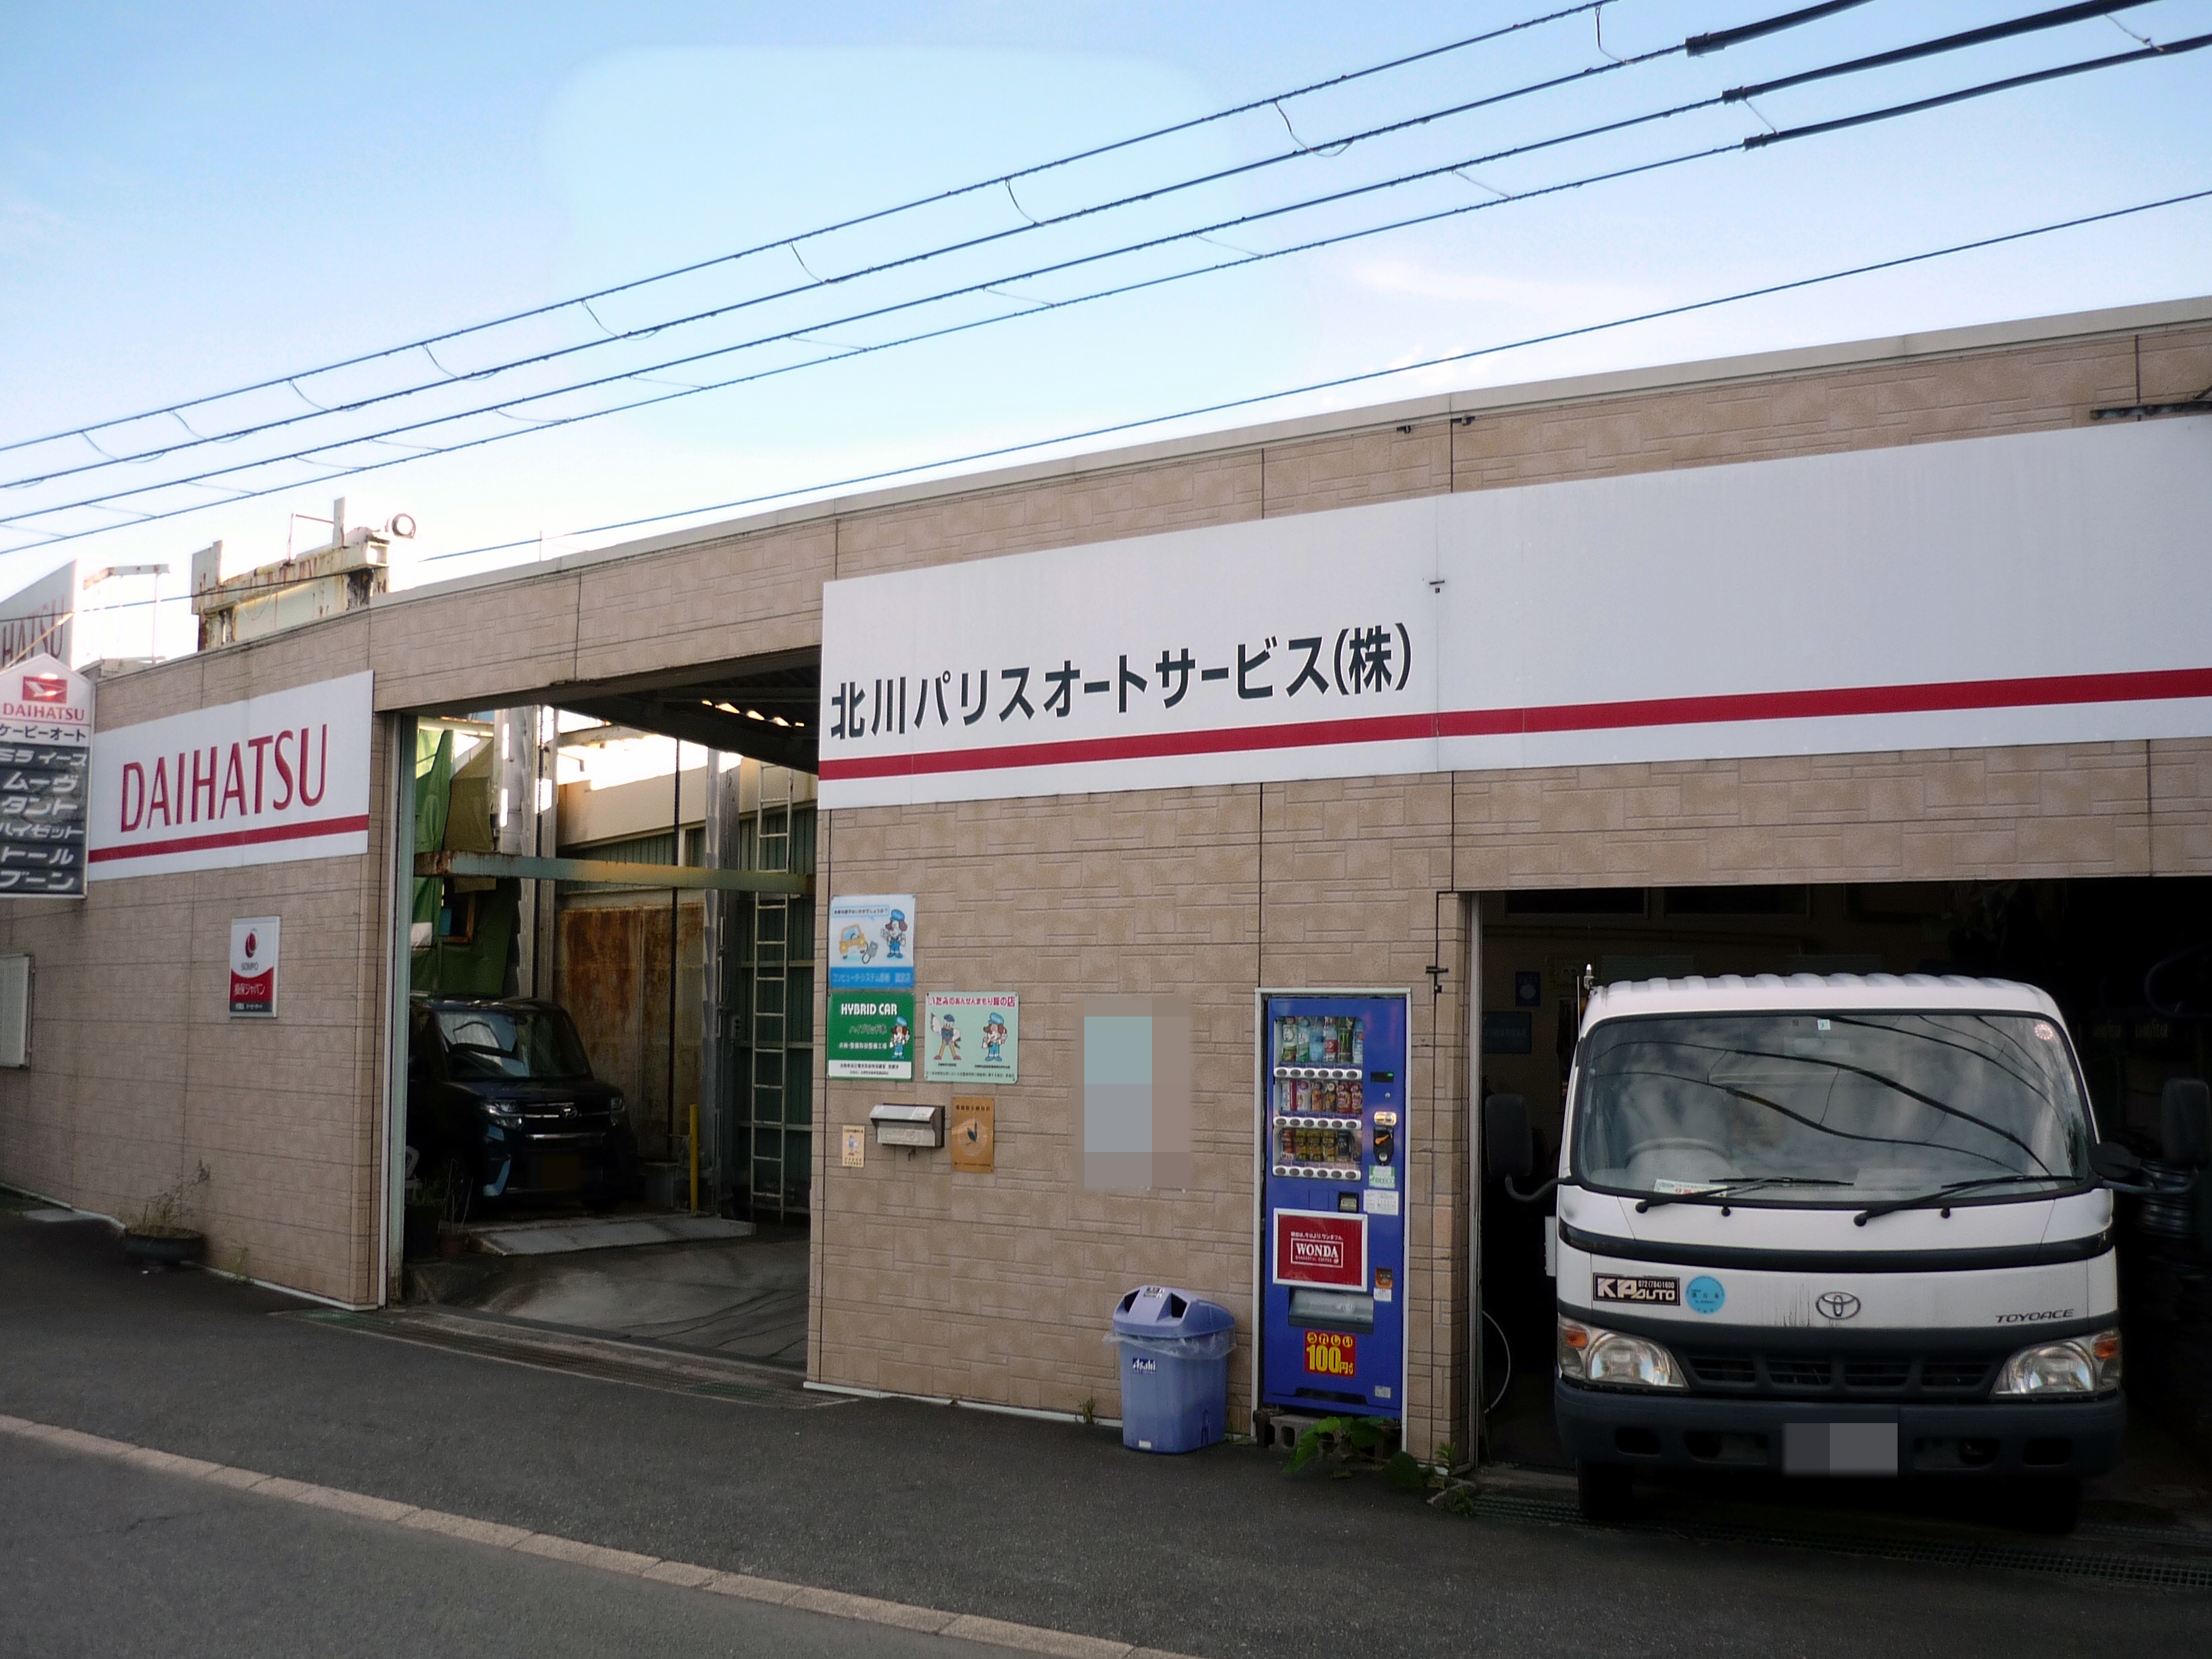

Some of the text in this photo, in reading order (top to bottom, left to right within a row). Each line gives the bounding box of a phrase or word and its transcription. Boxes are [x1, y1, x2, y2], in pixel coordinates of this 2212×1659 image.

[831, 622, 1411, 739] 北川パリスオートサービス(株)
[3, 703, 85, 720] DAIHATSU
[4, 771, 79, 792] ムーヴ
[121, 724, 328, 833] DAIHATSU
[2, 796, 78, 815] タント
[1, 846, 74, 865] トール
[0, 871, 74, 889] ブーン
[241, 962, 259, 970] SOMPO
[841, 1003, 898, 1015] HYBRID CAR
[1296, 1243, 1338, 1258] WONDA
[1597, 1277, 1637, 1298] KP
[1631, 1289, 1675, 1300] AUTO
[1995, 1308, 2074, 1323] TOYOACE
[1307, 1332, 1353, 1348] うれしい
